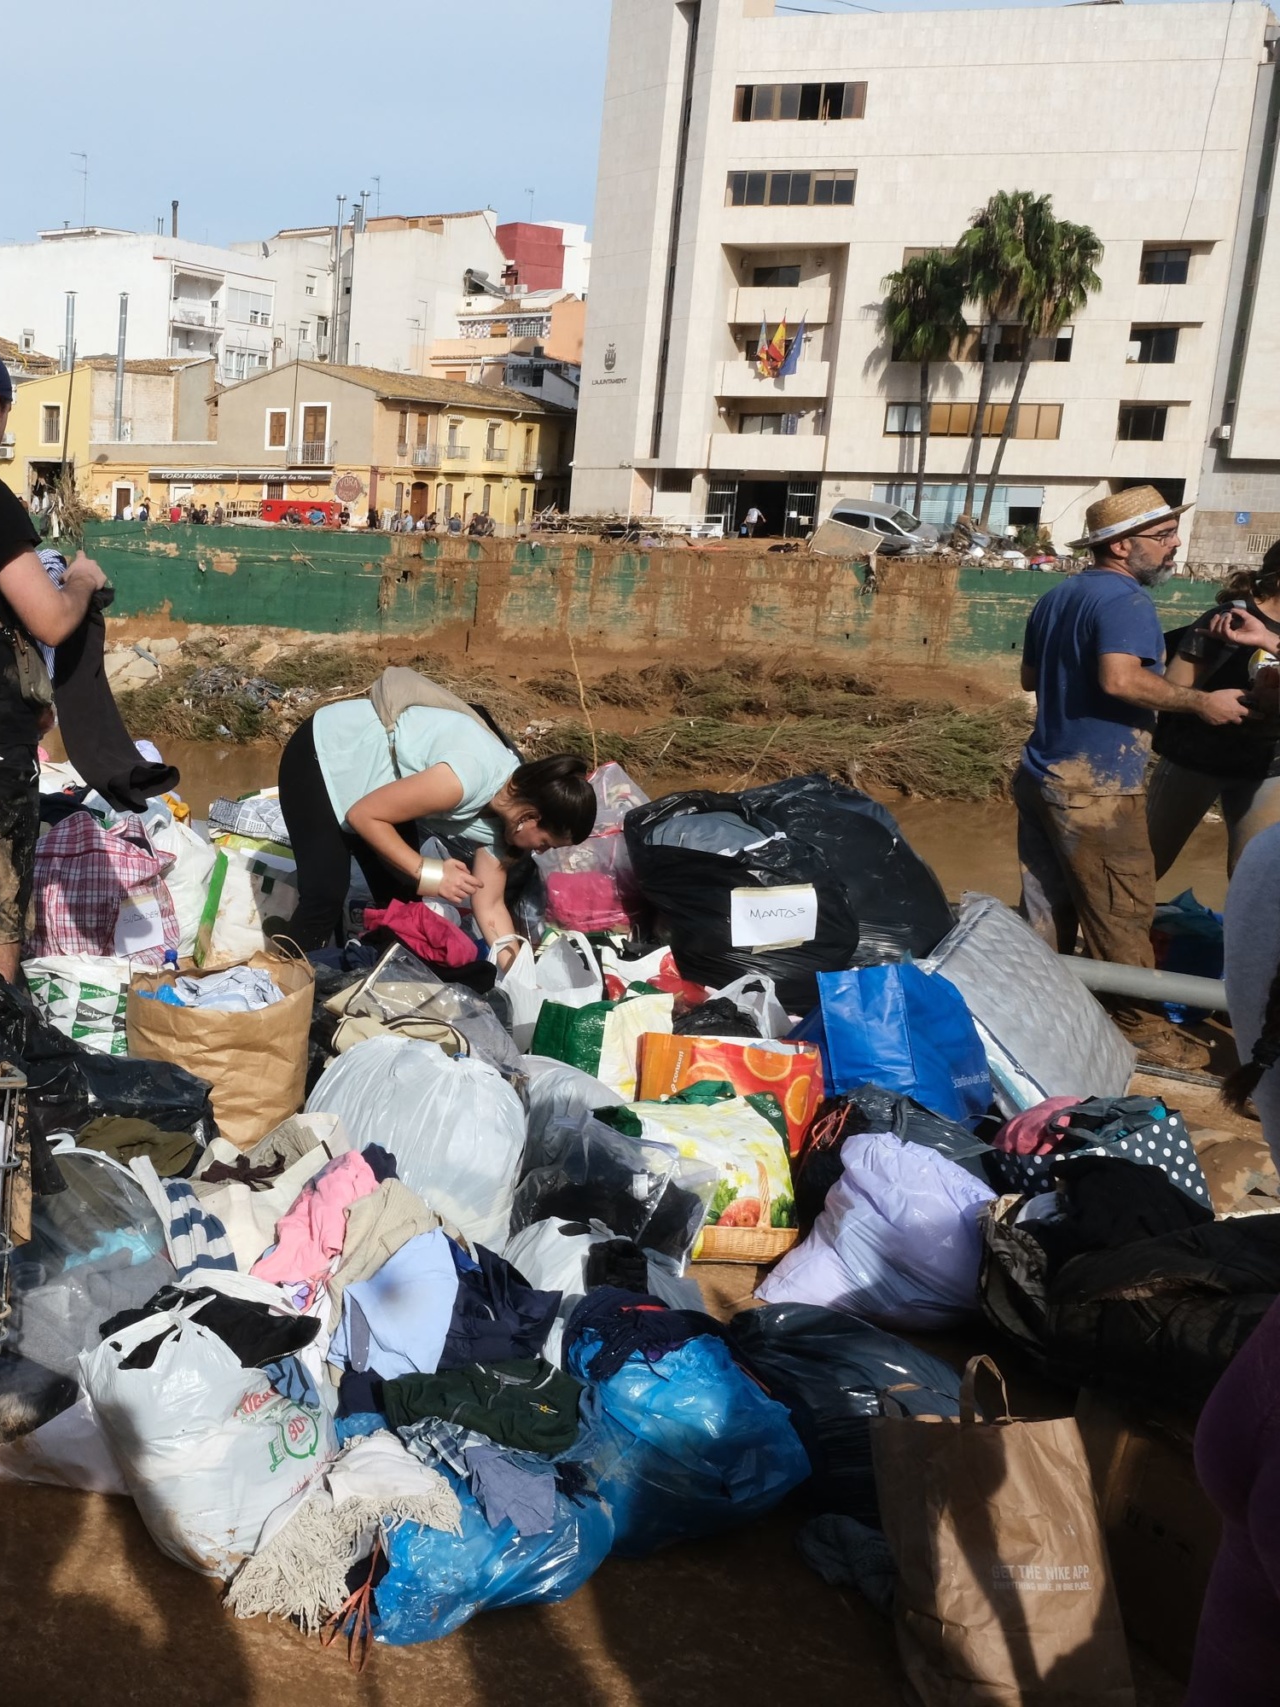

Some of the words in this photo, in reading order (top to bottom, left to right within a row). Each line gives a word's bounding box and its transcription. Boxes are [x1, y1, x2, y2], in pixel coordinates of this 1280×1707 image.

[750, 907, 806, 919] MANTAS
[992, 1564, 1015, 1579] GET
[1017, 1564, 1042, 1580] THE
[1045, 1565, 1071, 1581] NIKE
[1073, 1564, 1090, 1579] APP
